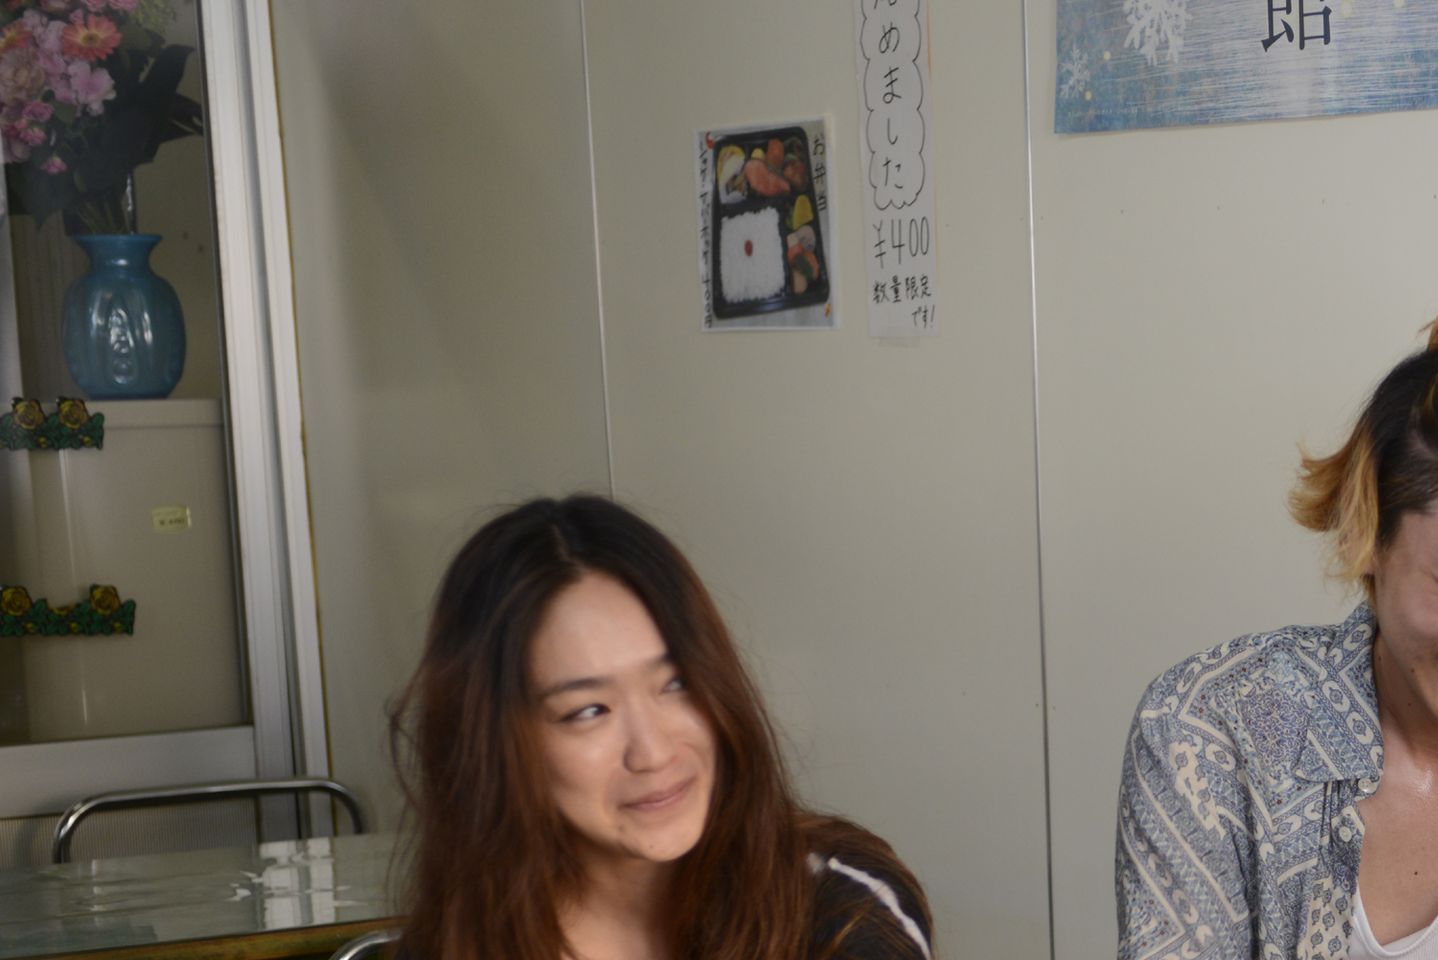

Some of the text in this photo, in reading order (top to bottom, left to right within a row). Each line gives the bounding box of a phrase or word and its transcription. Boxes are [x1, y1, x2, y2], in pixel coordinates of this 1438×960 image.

[874, 0, 902, 189] めました
[872, 216, 930, 270] ¥400
